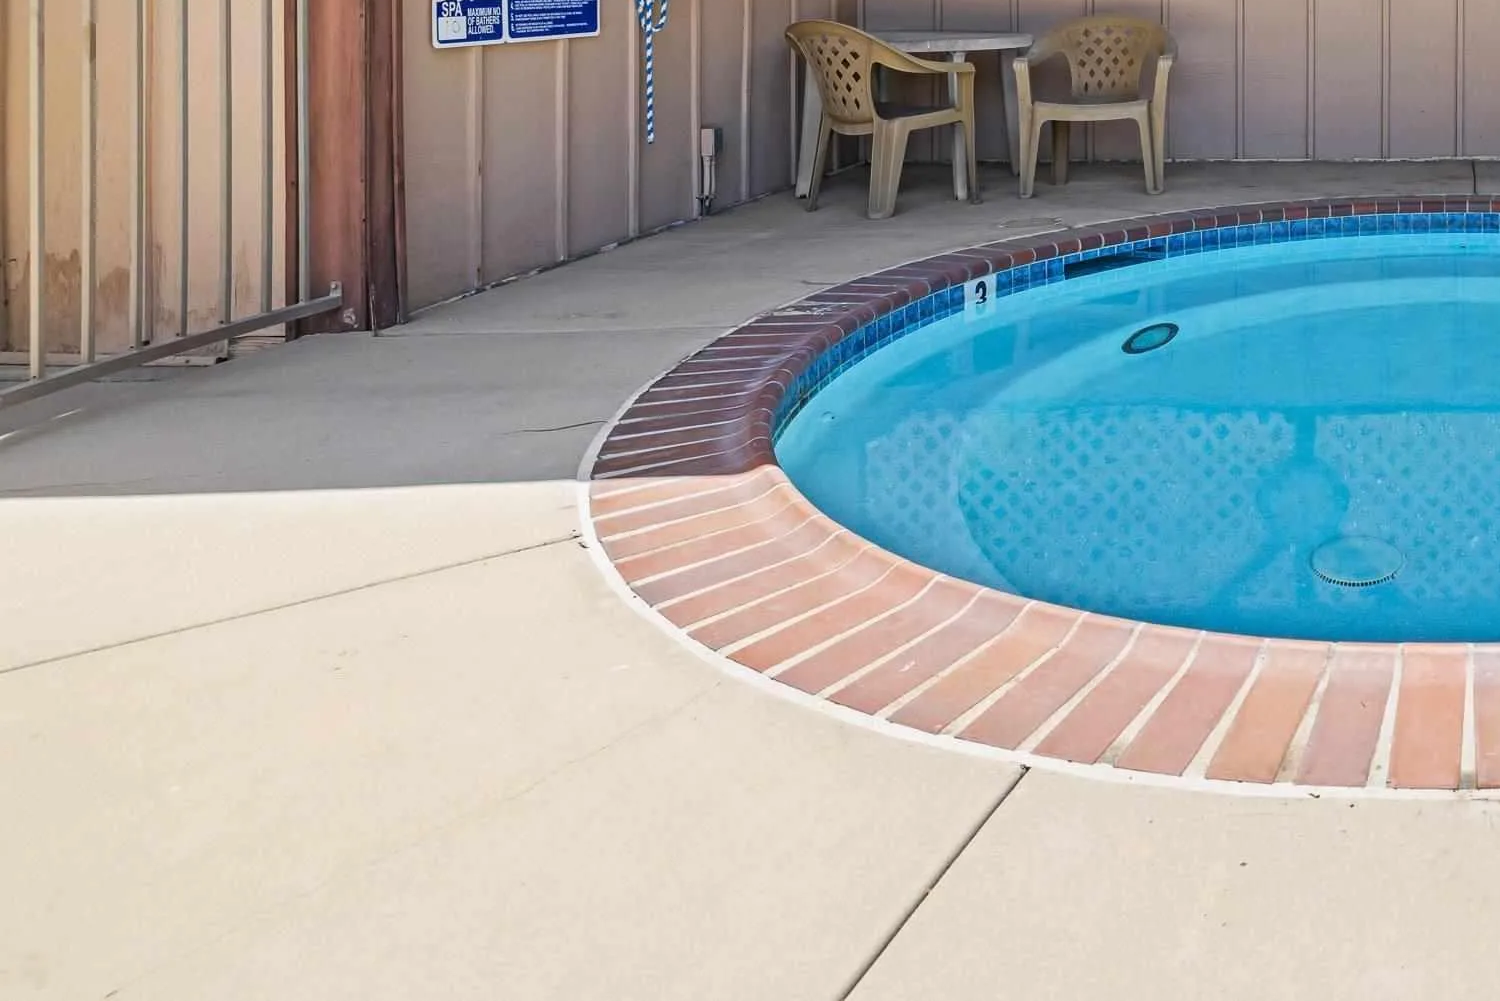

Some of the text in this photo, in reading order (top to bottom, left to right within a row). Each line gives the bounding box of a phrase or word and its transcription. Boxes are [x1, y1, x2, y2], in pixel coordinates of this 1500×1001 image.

[441, 1, 463, 17] SPA
[467, 7, 492, 17] MAXIMUM
[467, 15, 500, 26] OF BATHERS
[975, 281, 987, 305] 3
